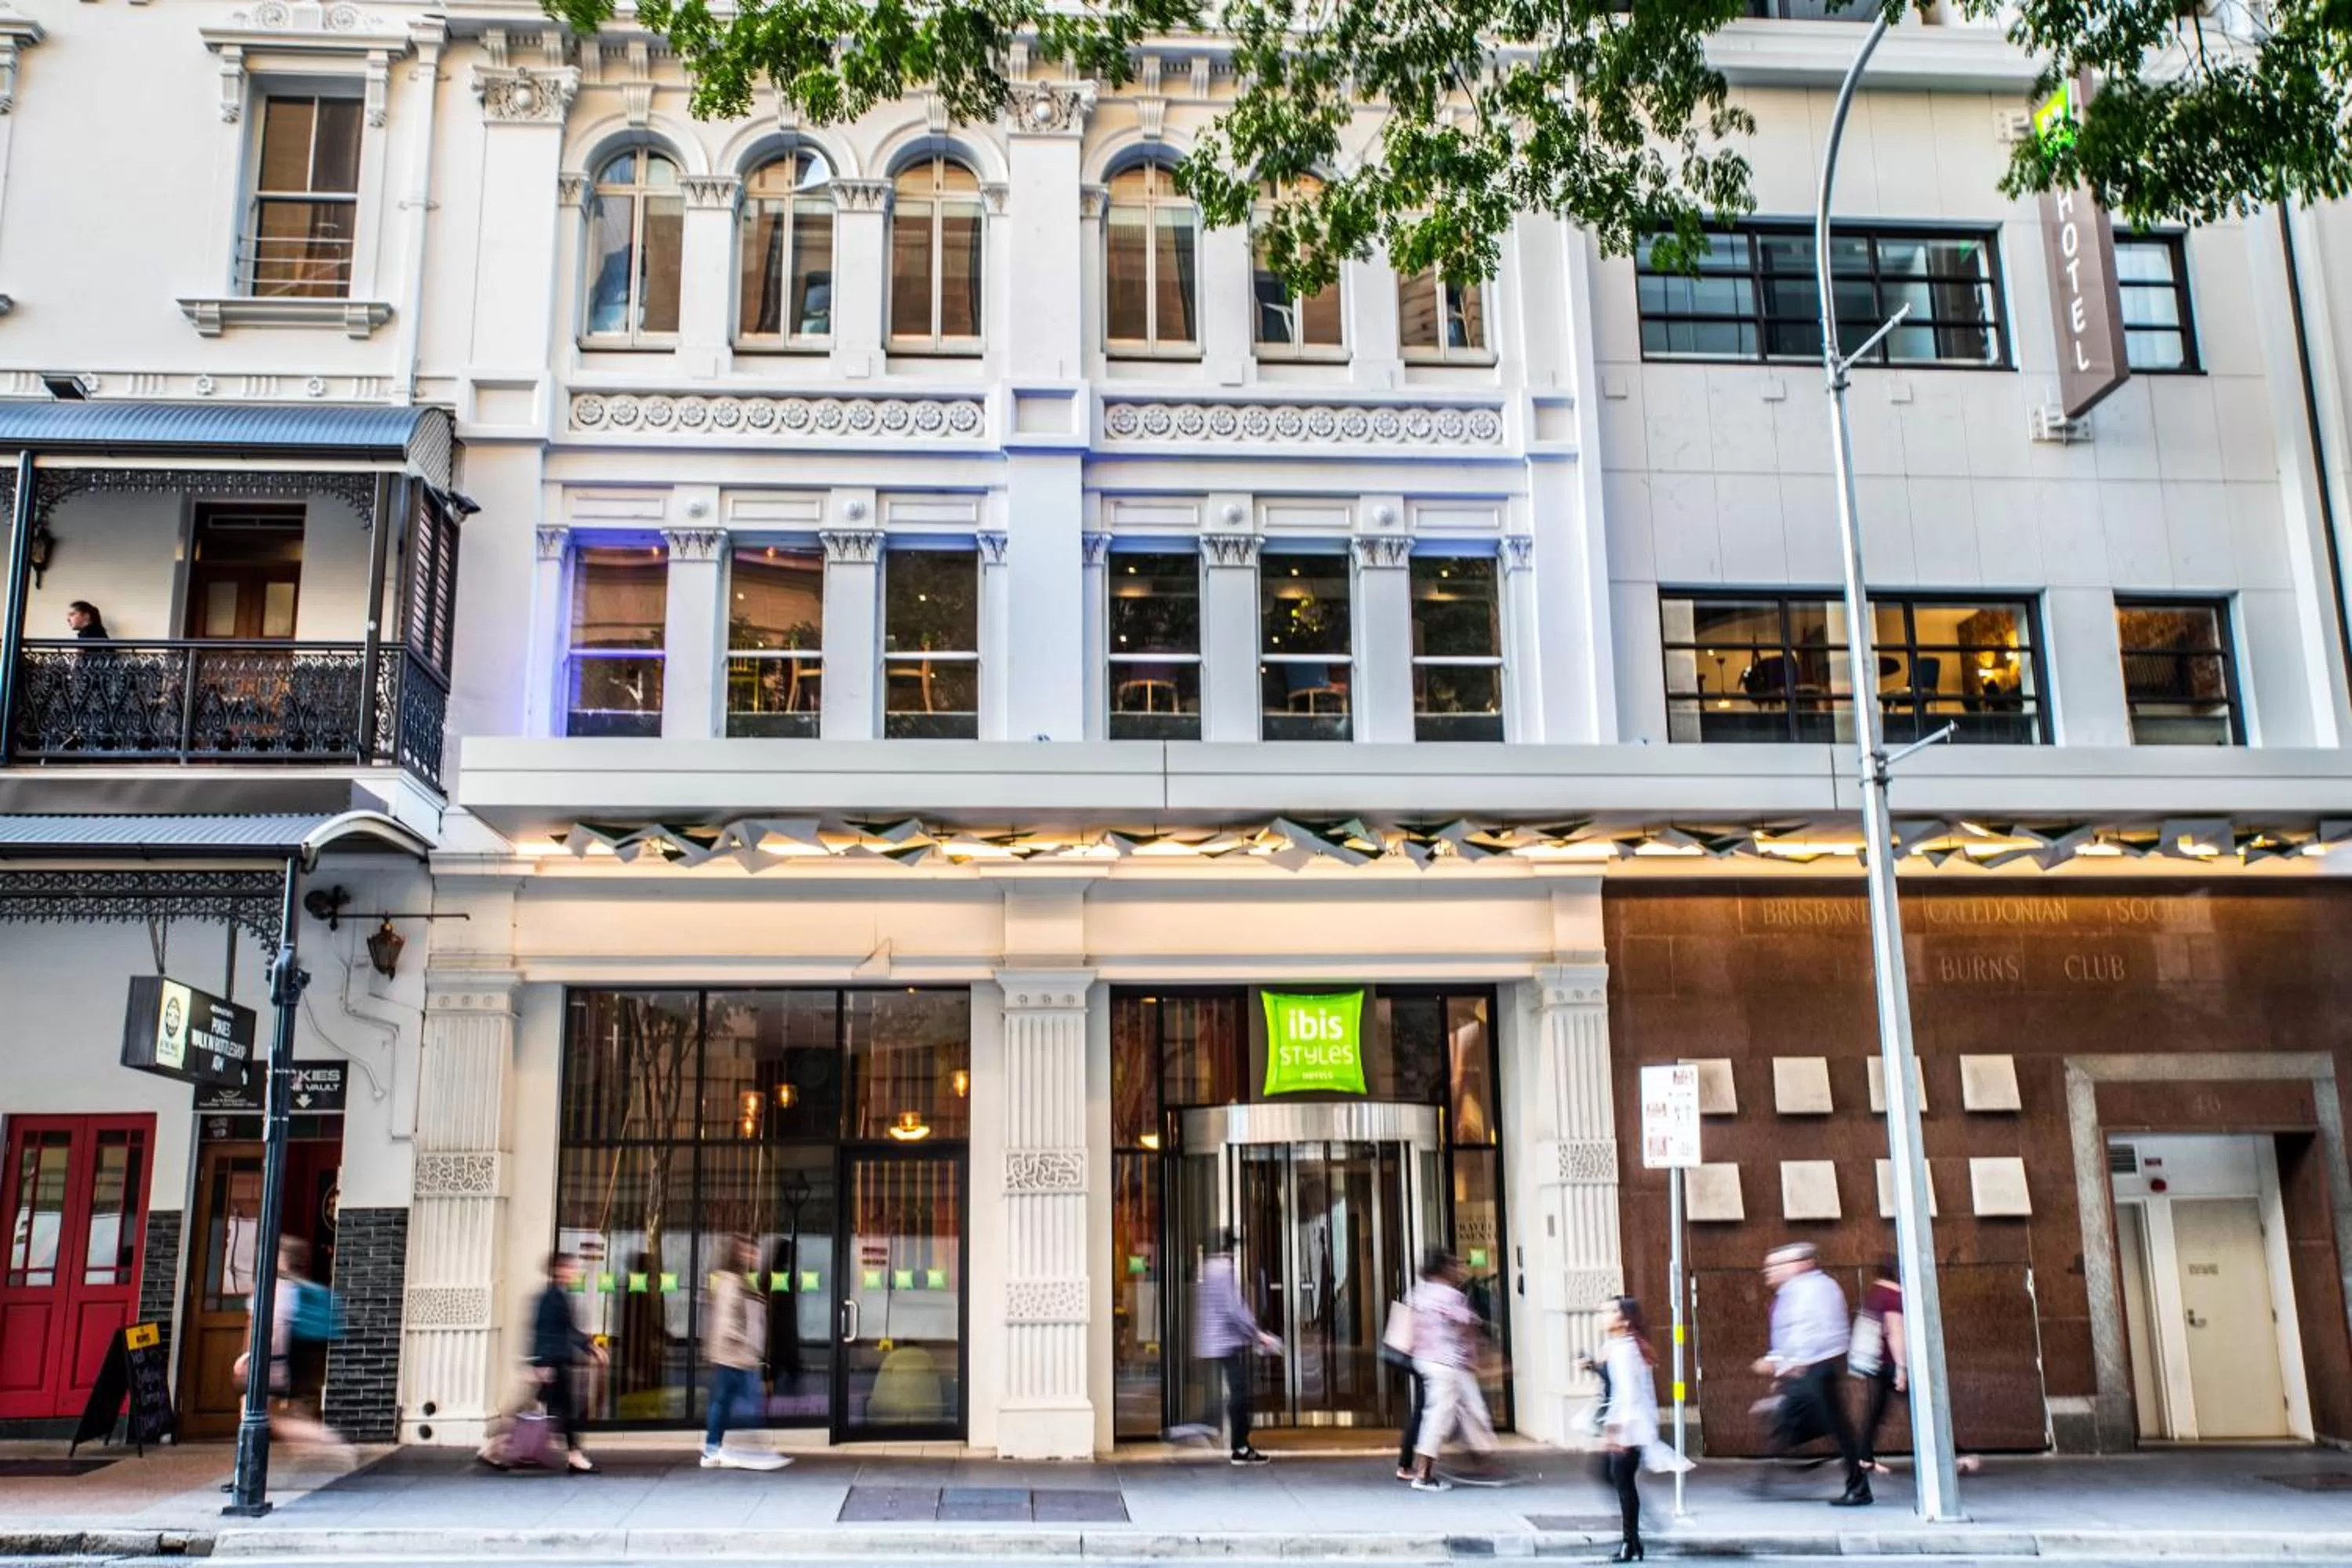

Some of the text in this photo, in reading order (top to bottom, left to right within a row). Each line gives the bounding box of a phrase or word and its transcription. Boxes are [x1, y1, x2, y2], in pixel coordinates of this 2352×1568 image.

[2056, 185, 2089, 371] HOTEL
[1927, 898, 2068, 924] CALEDONIAN
[1940, 954, 2125, 982] BURNS CLUB
[1288, 1007, 1344, 1040] ibis
